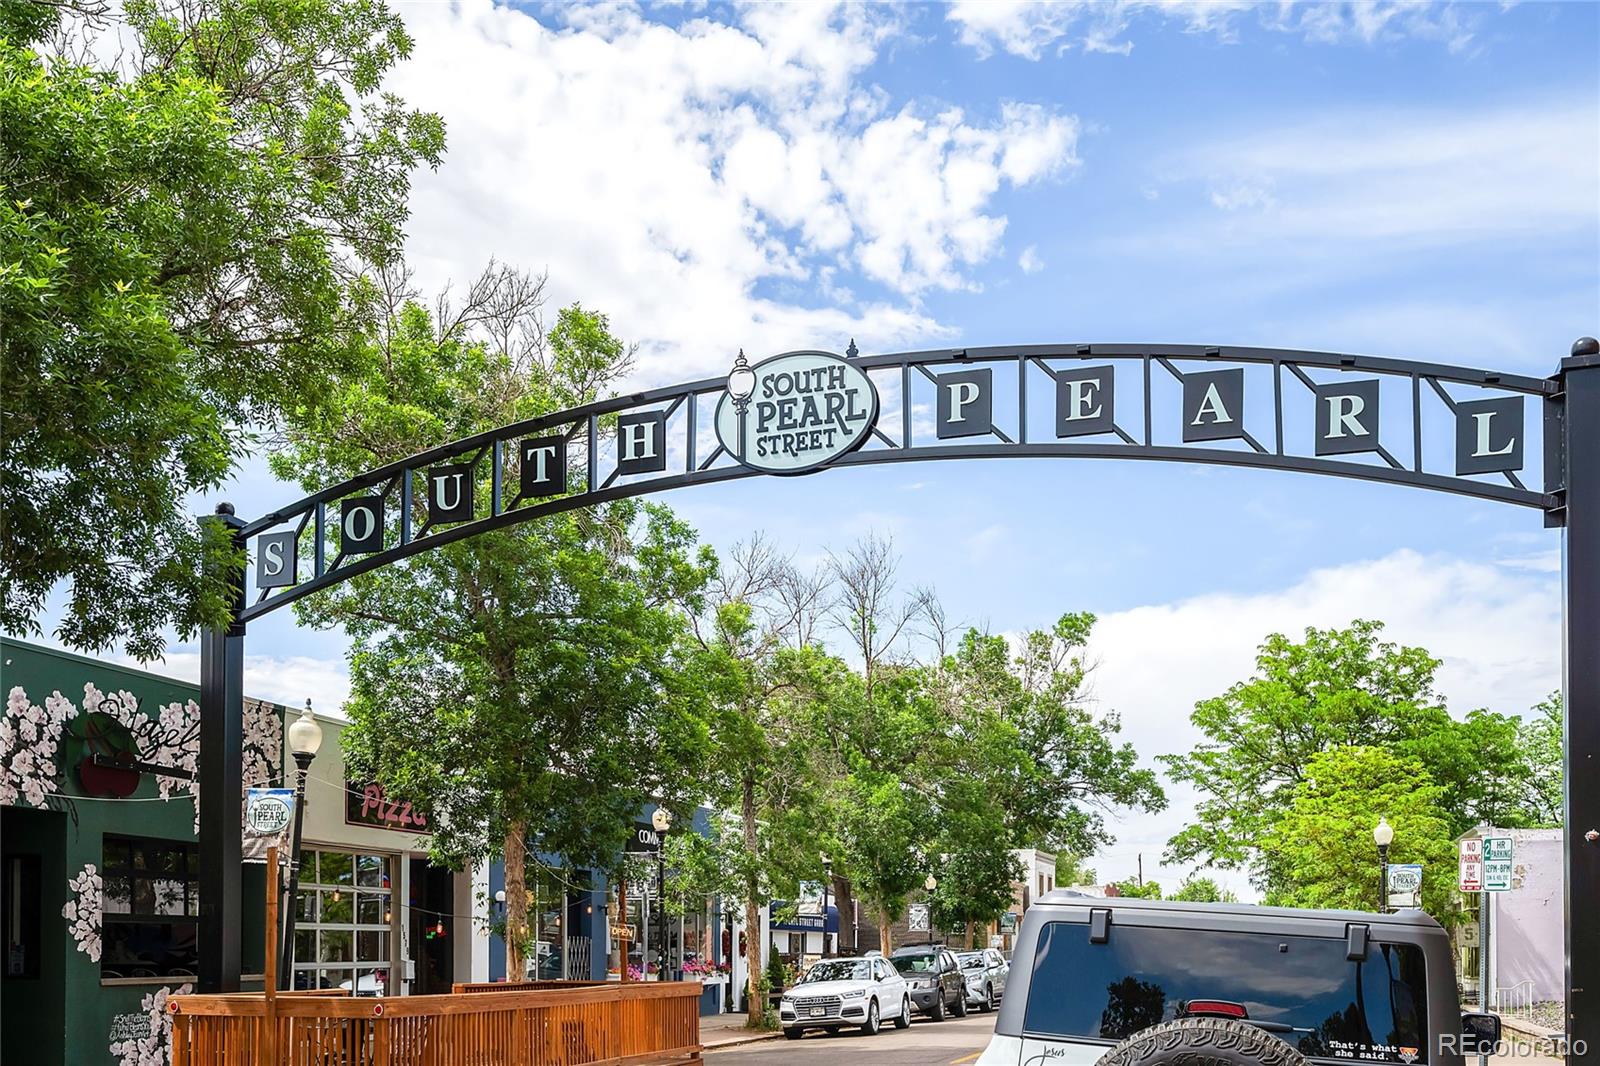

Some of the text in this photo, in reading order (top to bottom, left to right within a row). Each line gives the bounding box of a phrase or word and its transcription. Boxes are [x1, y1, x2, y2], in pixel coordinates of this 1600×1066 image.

[762, 365, 846, 398] SOUTH
[756, 388, 867, 436] PEARL
[757, 428, 837, 457] STREET
[260, 803, 282, 811] SOUTH
[257, 811, 287, 825] PEARL
[1466, 842, 1476, 852] NO
[1484, 843, 1491, 857] 2
[1496, 841, 1506, 850] HR
[1461, 853, 1481, 864] PARKING
[1491, 849, 1511, 858] PARKING
[611, 927, 633, 938] OPEN
[1329, 1041, 1398, 1053] That's what
[1335, 1050, 1389, 1061] she said.
